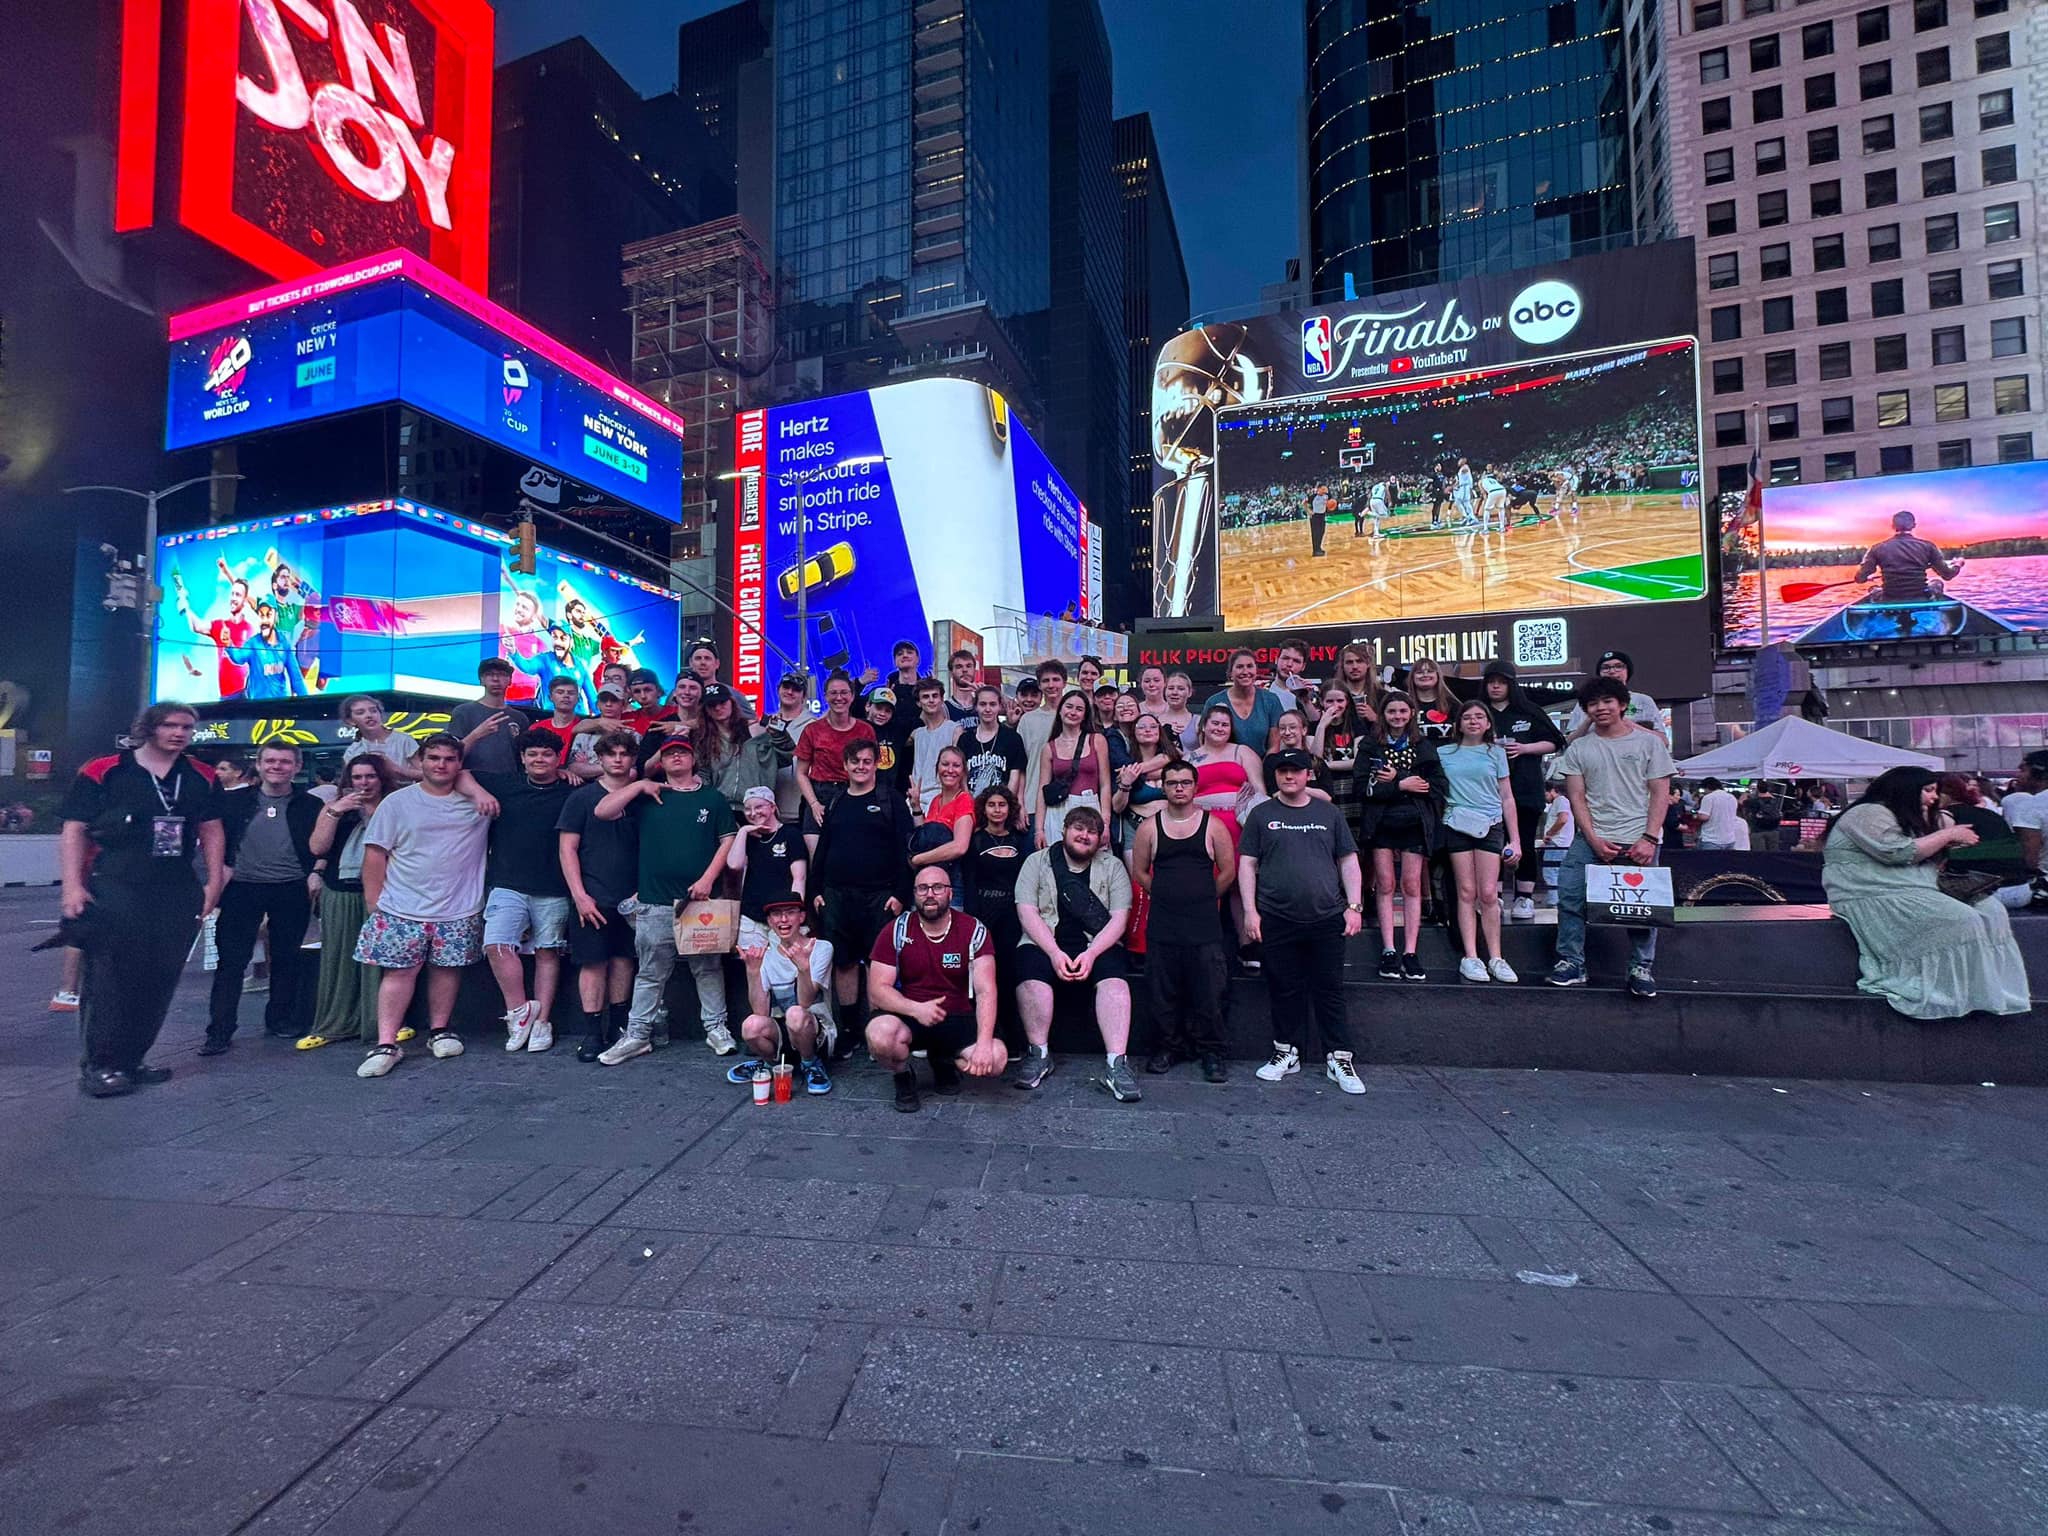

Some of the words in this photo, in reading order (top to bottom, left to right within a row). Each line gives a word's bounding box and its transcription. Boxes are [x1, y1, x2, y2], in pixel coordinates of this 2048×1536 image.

[248, 300, 265, 314] BUY
[267, 288, 301, 308] TICKETS
[301, 286, 313, 297] AT
[296, 339, 326, 356] NEW
[1316, 299, 1477, 383] Finals
[1482, 316, 1502, 331] ON
[1514, 299, 1575, 325] abc
[303, 363, 333, 382] JUNE
[1307, 361, 1321, 374] NBA
[1351, 365, 1378, 379] Presented
[1379, 362, 1389, 376] by
[1565, 367, 1591, 380] MAKE
[1592, 360, 1616, 374] SOME
[203, 404, 233, 420] WORLD
[234, 400, 250, 413] CUP
[507, 417, 528, 433] CUP
[598, 412, 627, 433] CRICKET
[627, 428, 635, 438] IN
[780, 416, 829, 439] Hertz
[584, 414, 612, 441] NEW
[616, 431, 648, 459] YORK
[592, 443, 620, 467] JUNE
[622, 457, 641, 476] 3-12
[780, 441, 835, 463] makes
[860, 461, 870, 475] a
[847, 481, 880, 502] ride
[779, 515, 813, 536] wih
[817, 509, 872, 532] Stripe.
[739, 586, 761, 685] CHOCOLATE
[1400, 632, 1457, 664] LISTEN
[1462, 630, 1498, 661] LIVE
[1140, 650, 1181, 665] KLIK
[1268, 821, 1328, 833] Champion
[1611, 872, 1622, 886] I
[1608, 887, 1649, 904] NY
[1609, 904, 1652, 916] GIFTS
